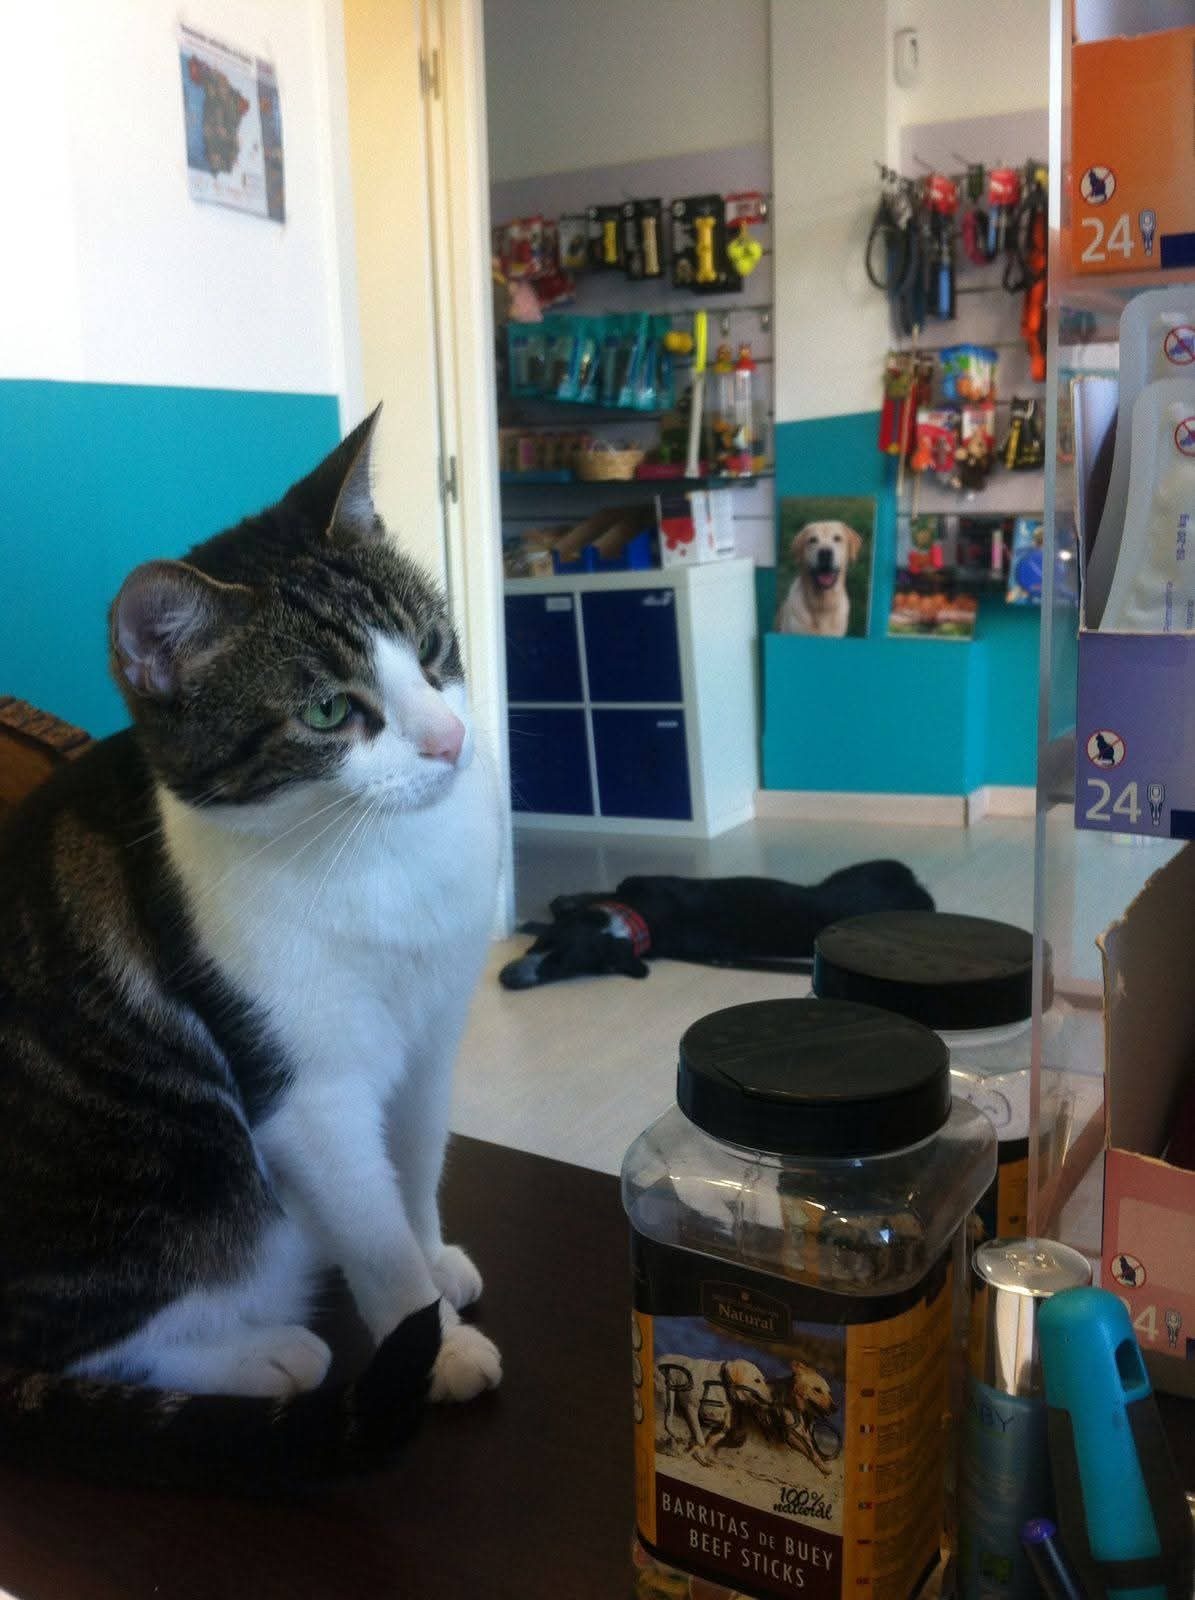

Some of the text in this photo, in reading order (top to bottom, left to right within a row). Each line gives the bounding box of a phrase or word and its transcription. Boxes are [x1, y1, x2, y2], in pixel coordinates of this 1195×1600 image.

[1081, 213, 1135, 263] 24
[1085, 778, 1142, 823] 24
[719, 1303, 774, 1330] Natural
[780, 1487, 825, 1508] 100%
[661, 1492, 750, 1539] BARRITAS
[759, 1531, 777, 1551] DE
[785, 1536, 834, 1571] BUEY
[689, 1529, 805, 1588] BEEF STICKS
